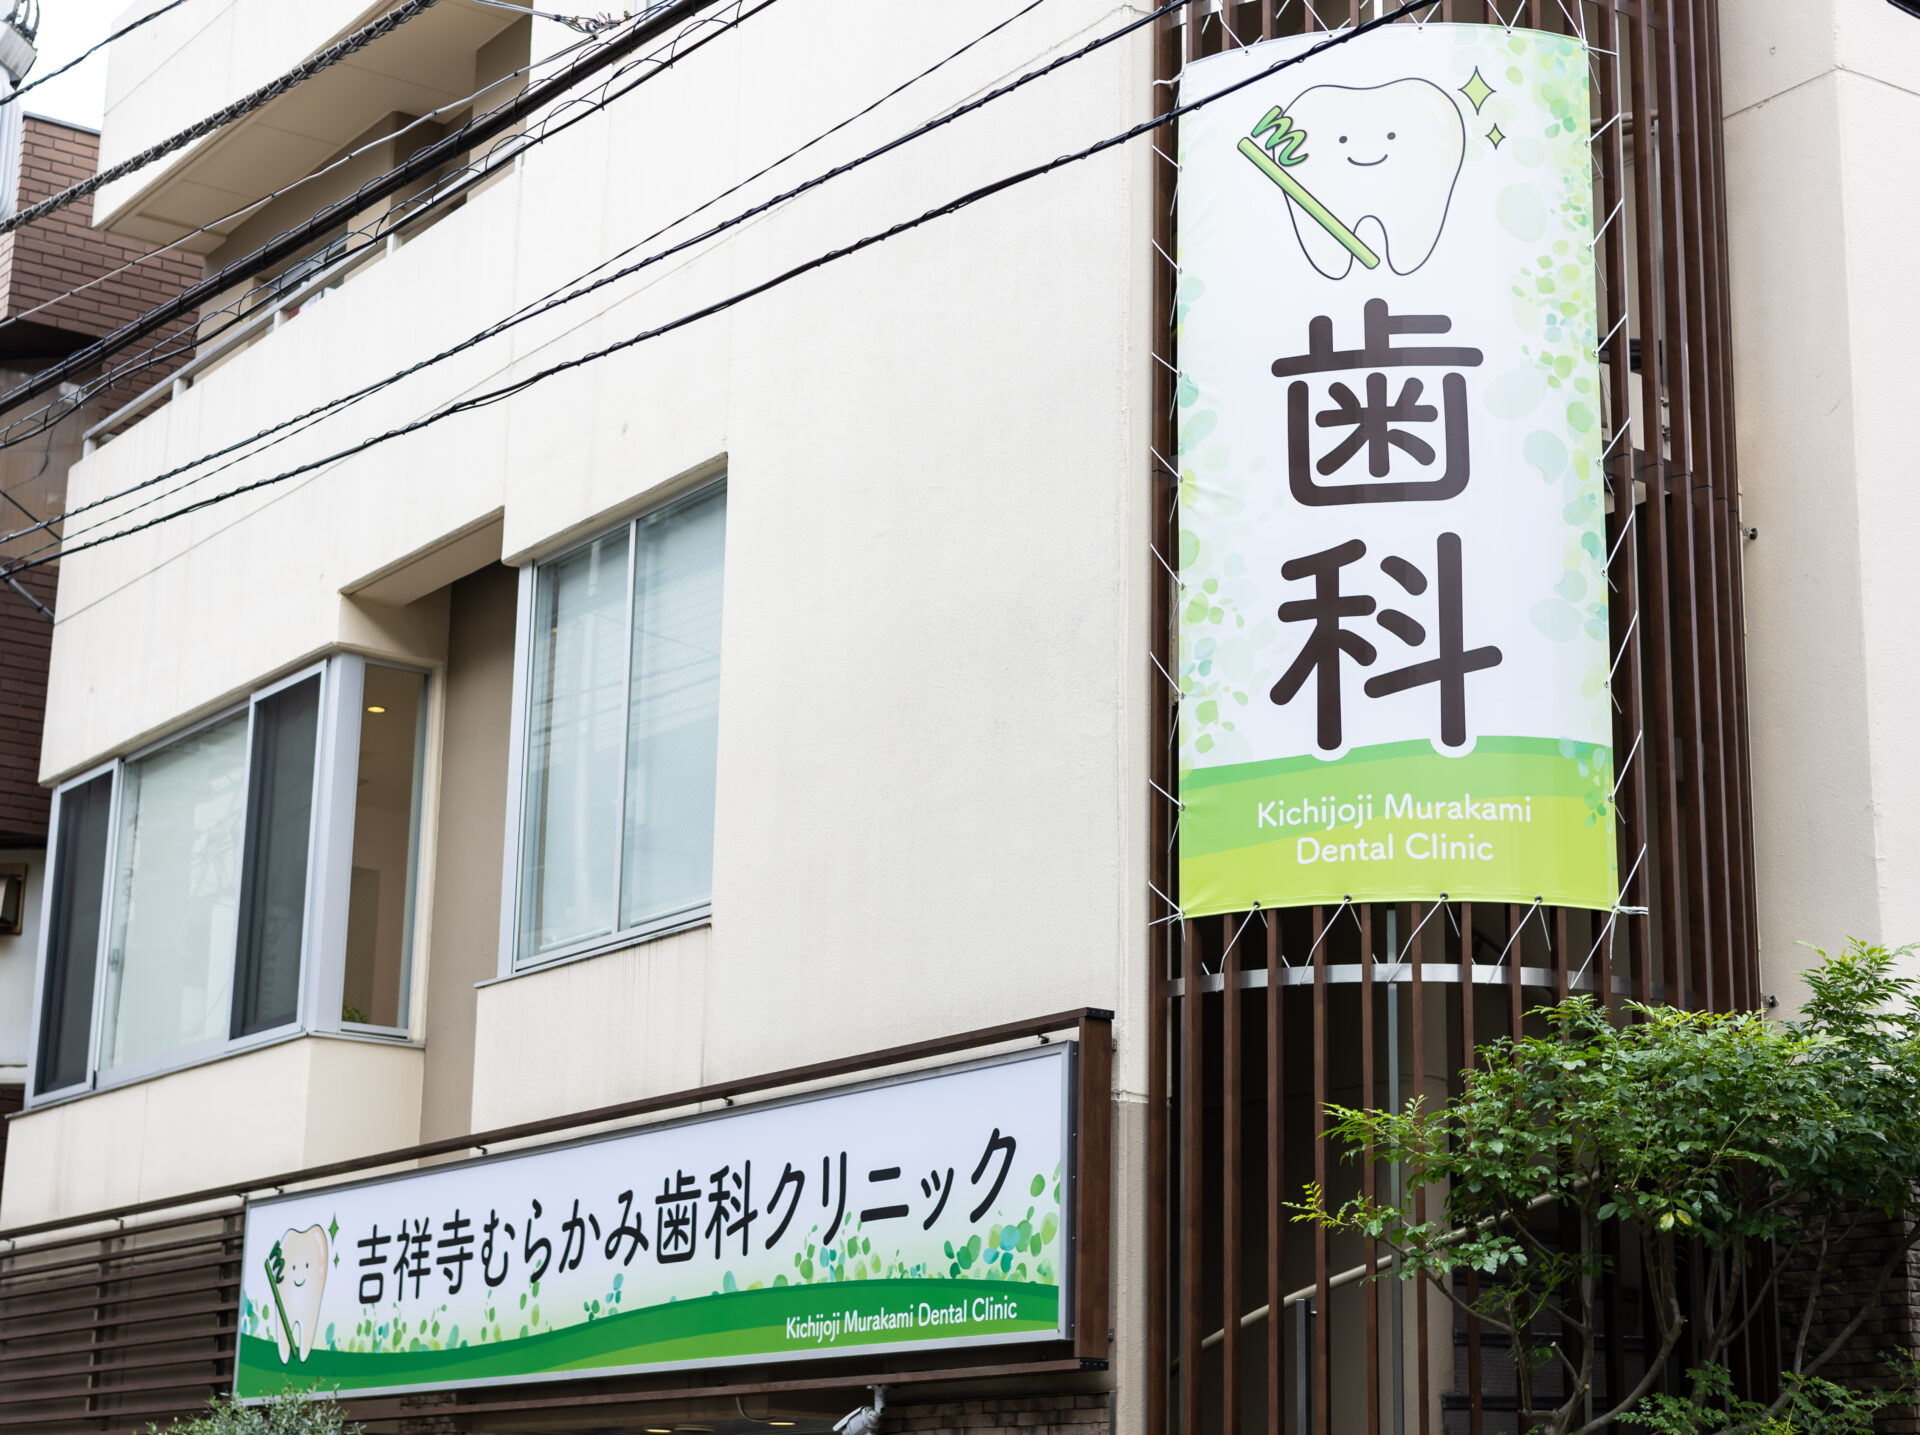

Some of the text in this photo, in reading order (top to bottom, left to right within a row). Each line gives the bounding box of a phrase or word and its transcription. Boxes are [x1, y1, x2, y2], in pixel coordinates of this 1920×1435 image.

[1270, 297, 1503, 750] 歯科
[1256, 793, 1533, 831] Kichijoji Murakami
[1295, 832, 1494, 864] Dental Clinic
[356, 1127, 1017, 1305] 吉祥寺むらかみ歯科クリニック
[785, 1296, 1018, 1343] Kichijoji Murakami Dental Clinic
